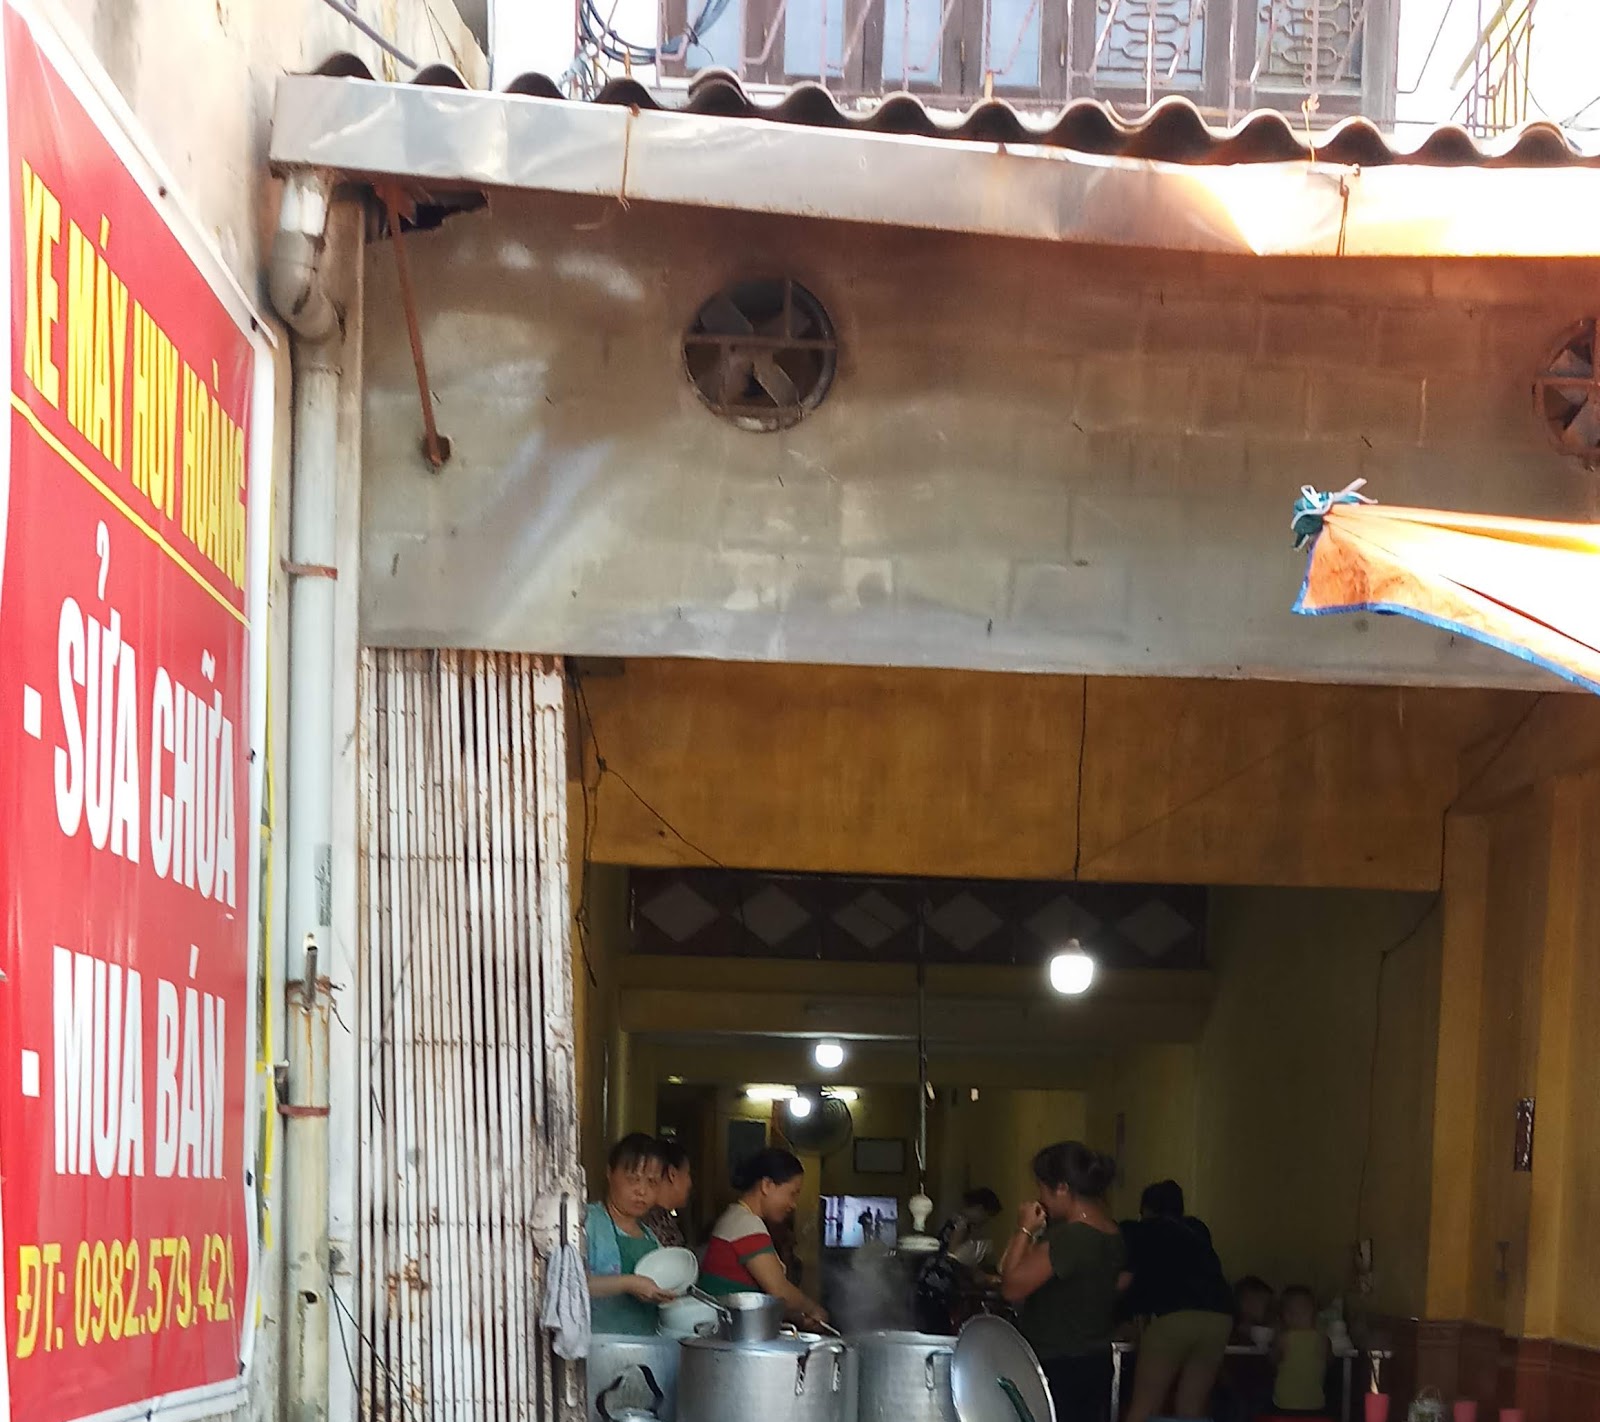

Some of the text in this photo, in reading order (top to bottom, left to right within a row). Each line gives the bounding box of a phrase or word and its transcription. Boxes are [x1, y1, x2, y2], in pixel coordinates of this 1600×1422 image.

[21, 157, 246, 592] XE MÁY HUY HOÀNG
[54, 519, 140, 865] SỬA
[150, 648, 237, 909] CHỮA
[53, 945, 144, 1179] MUA
[155, 944, 226, 1180] BÁN
[16, 1242, 65, 1359] ĐT:
